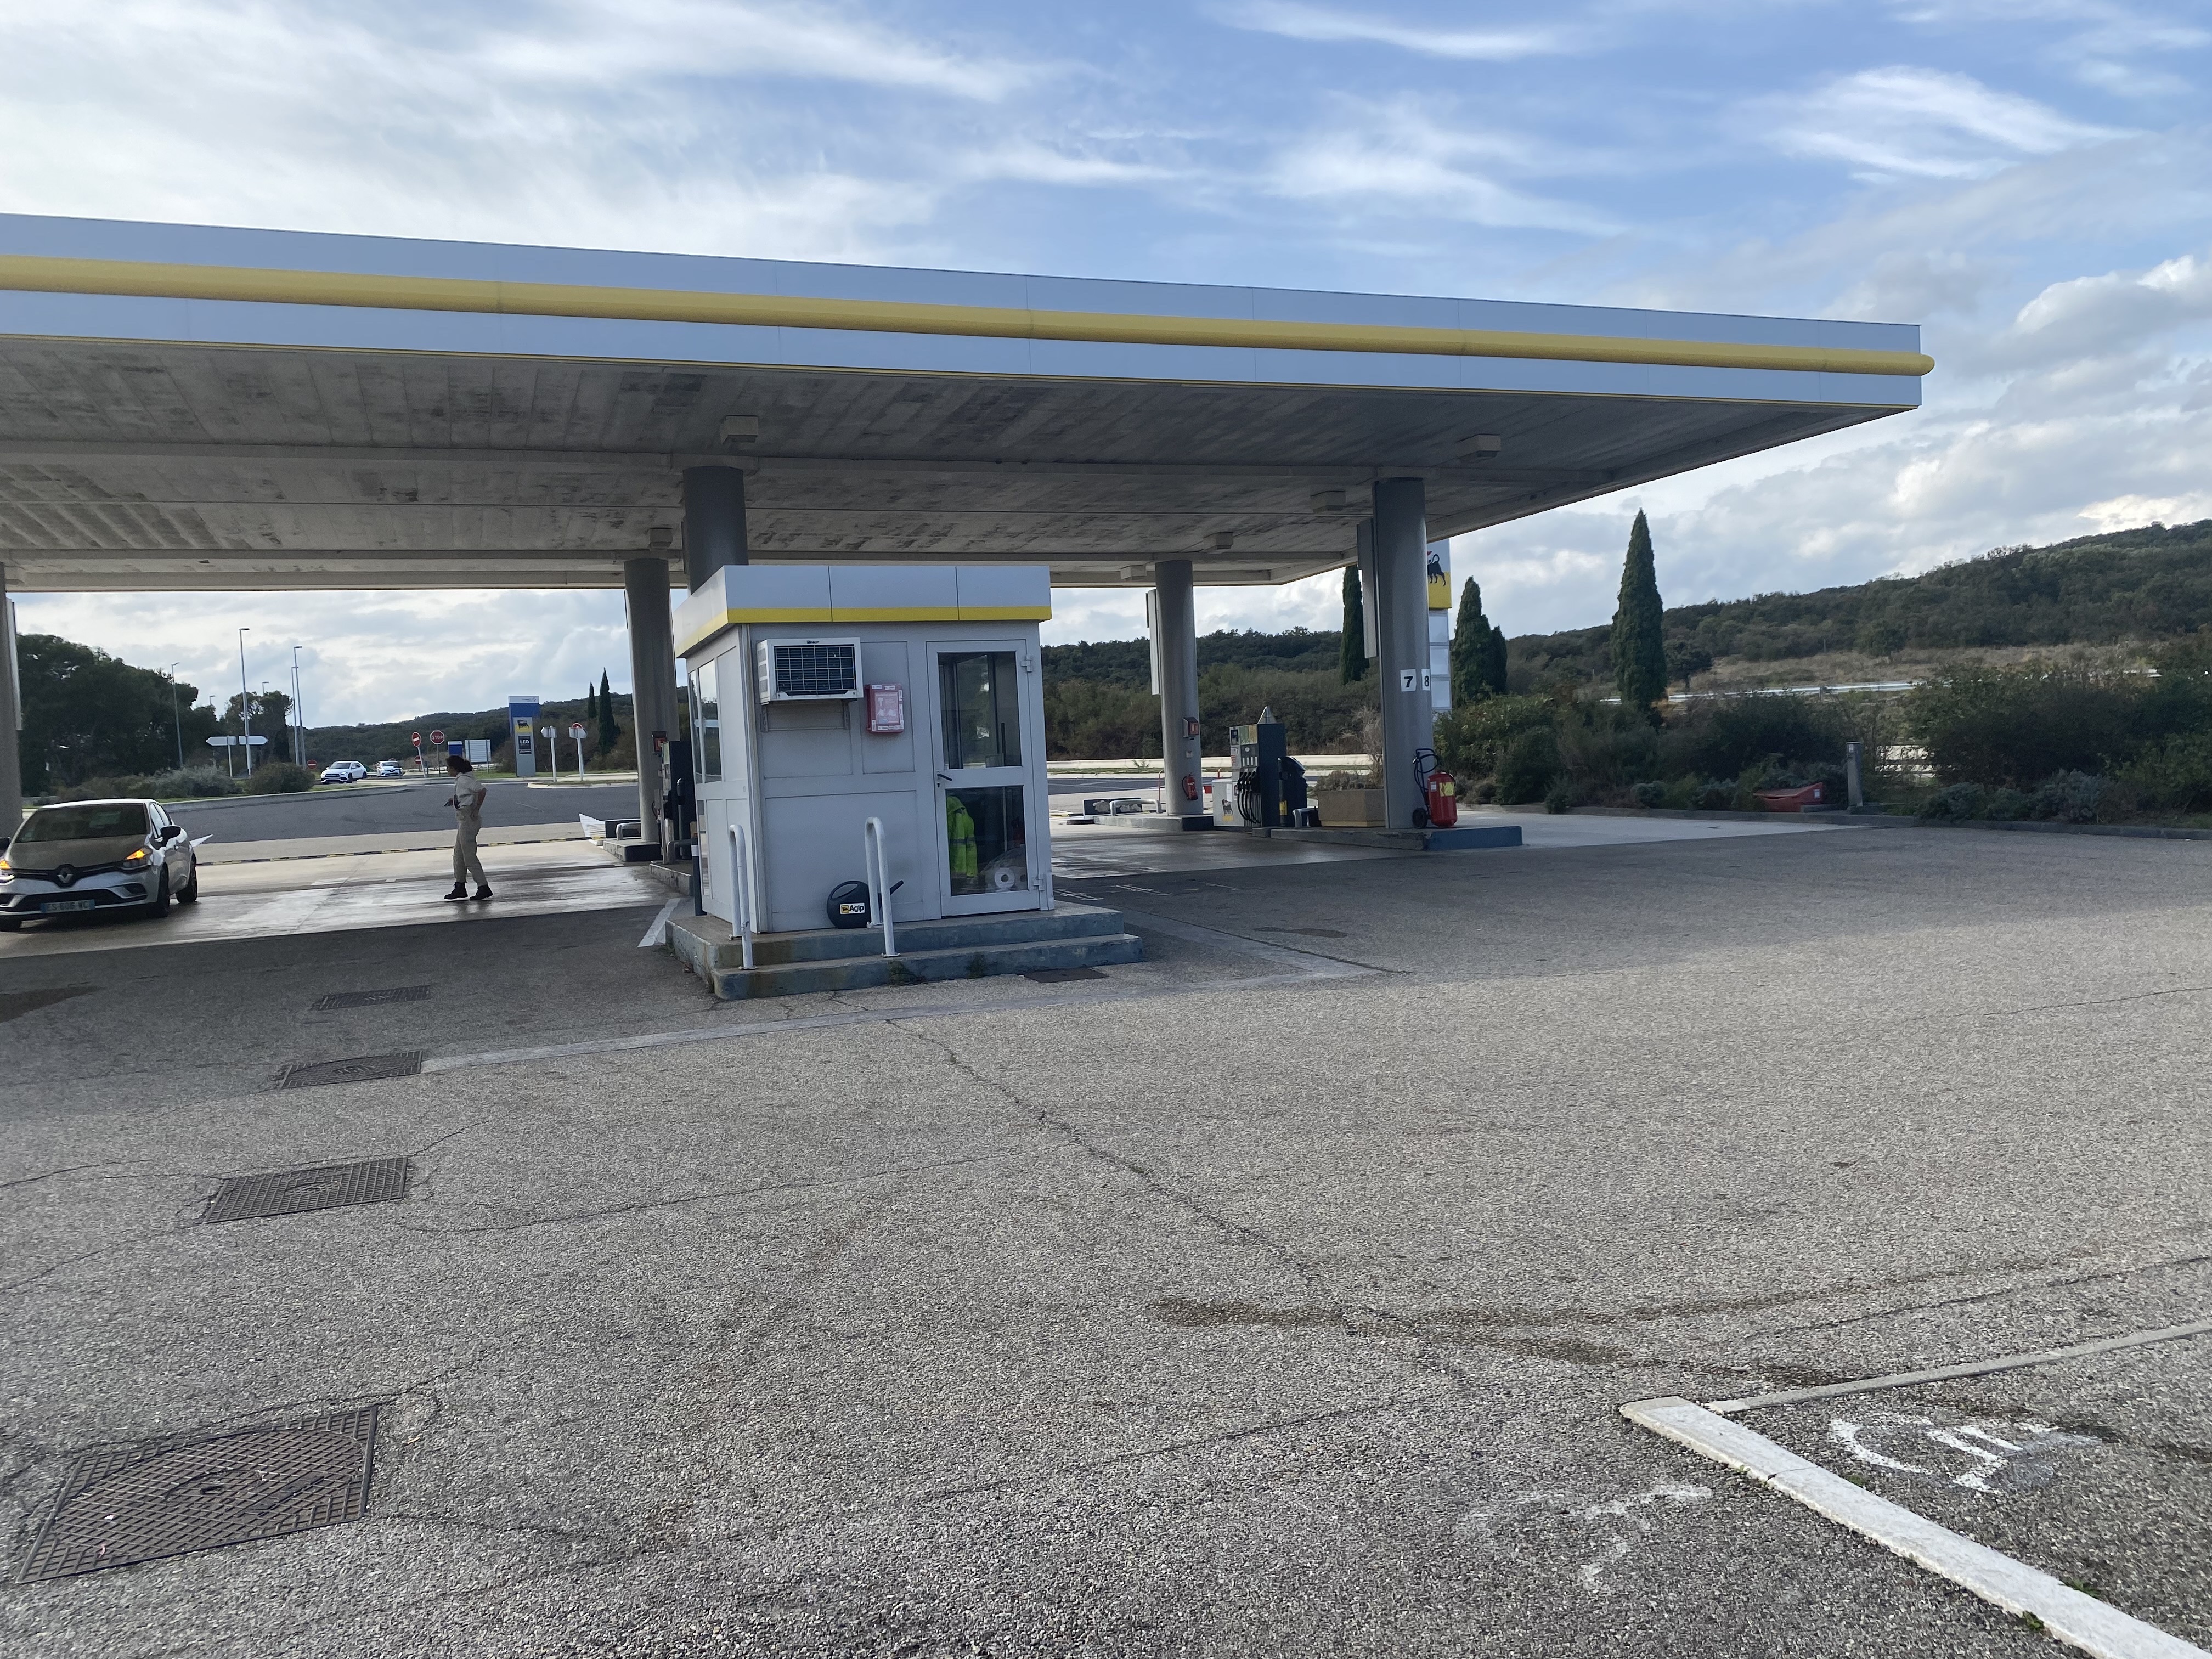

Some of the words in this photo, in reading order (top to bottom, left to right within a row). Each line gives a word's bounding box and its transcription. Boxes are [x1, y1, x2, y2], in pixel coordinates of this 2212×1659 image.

[1403, 675, 1414, 688] 7
[1424, 675, 1430, 687] 8
[850, 905, 865, 913] Agip
